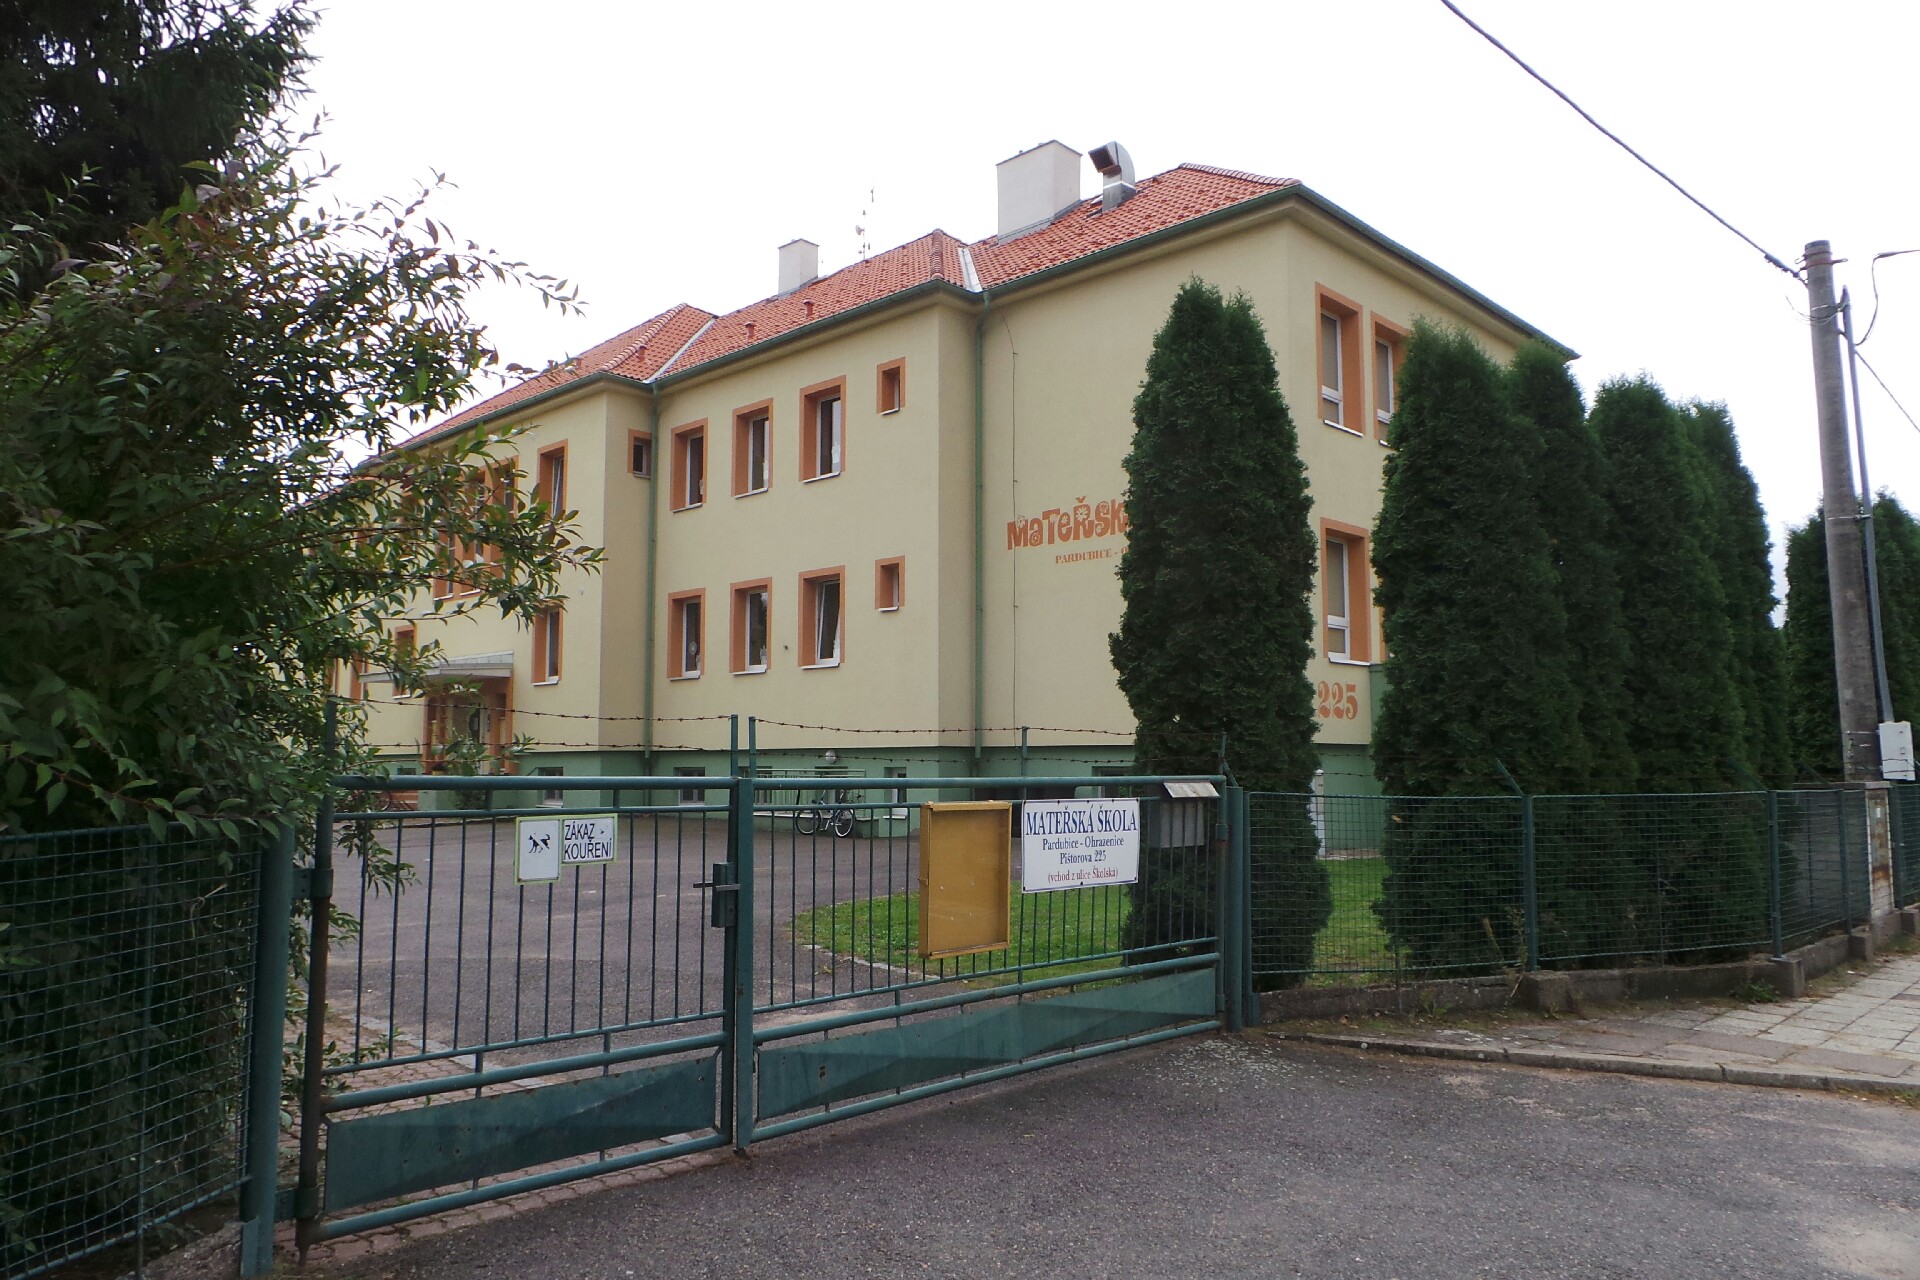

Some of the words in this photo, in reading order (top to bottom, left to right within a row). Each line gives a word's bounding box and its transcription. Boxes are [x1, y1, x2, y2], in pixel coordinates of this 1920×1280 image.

[1007, 496, 1128, 550] MaTeŘSK
[1055, 549, 1111, 564] PARDUBICE
[1317, 681, 1358, 719] 225
[1026, 804, 1095, 835] MATEŘSKÁ
[1097, 804, 1138, 832] ŠKOLA
[565, 821, 595, 840] ZÁKAZ
[564, 838, 612, 860] KOUŘENÍ
[1042, 837, 1079, 850] Pardubice
[1084, 835, 1125, 848] Ohrazenice
[1094, 850, 1106, 861] 225
[1048, 869, 1070, 884] (vchod
[1076, 868, 1091, 880] ulice
[1092, 866, 1119, 879] Školská)
